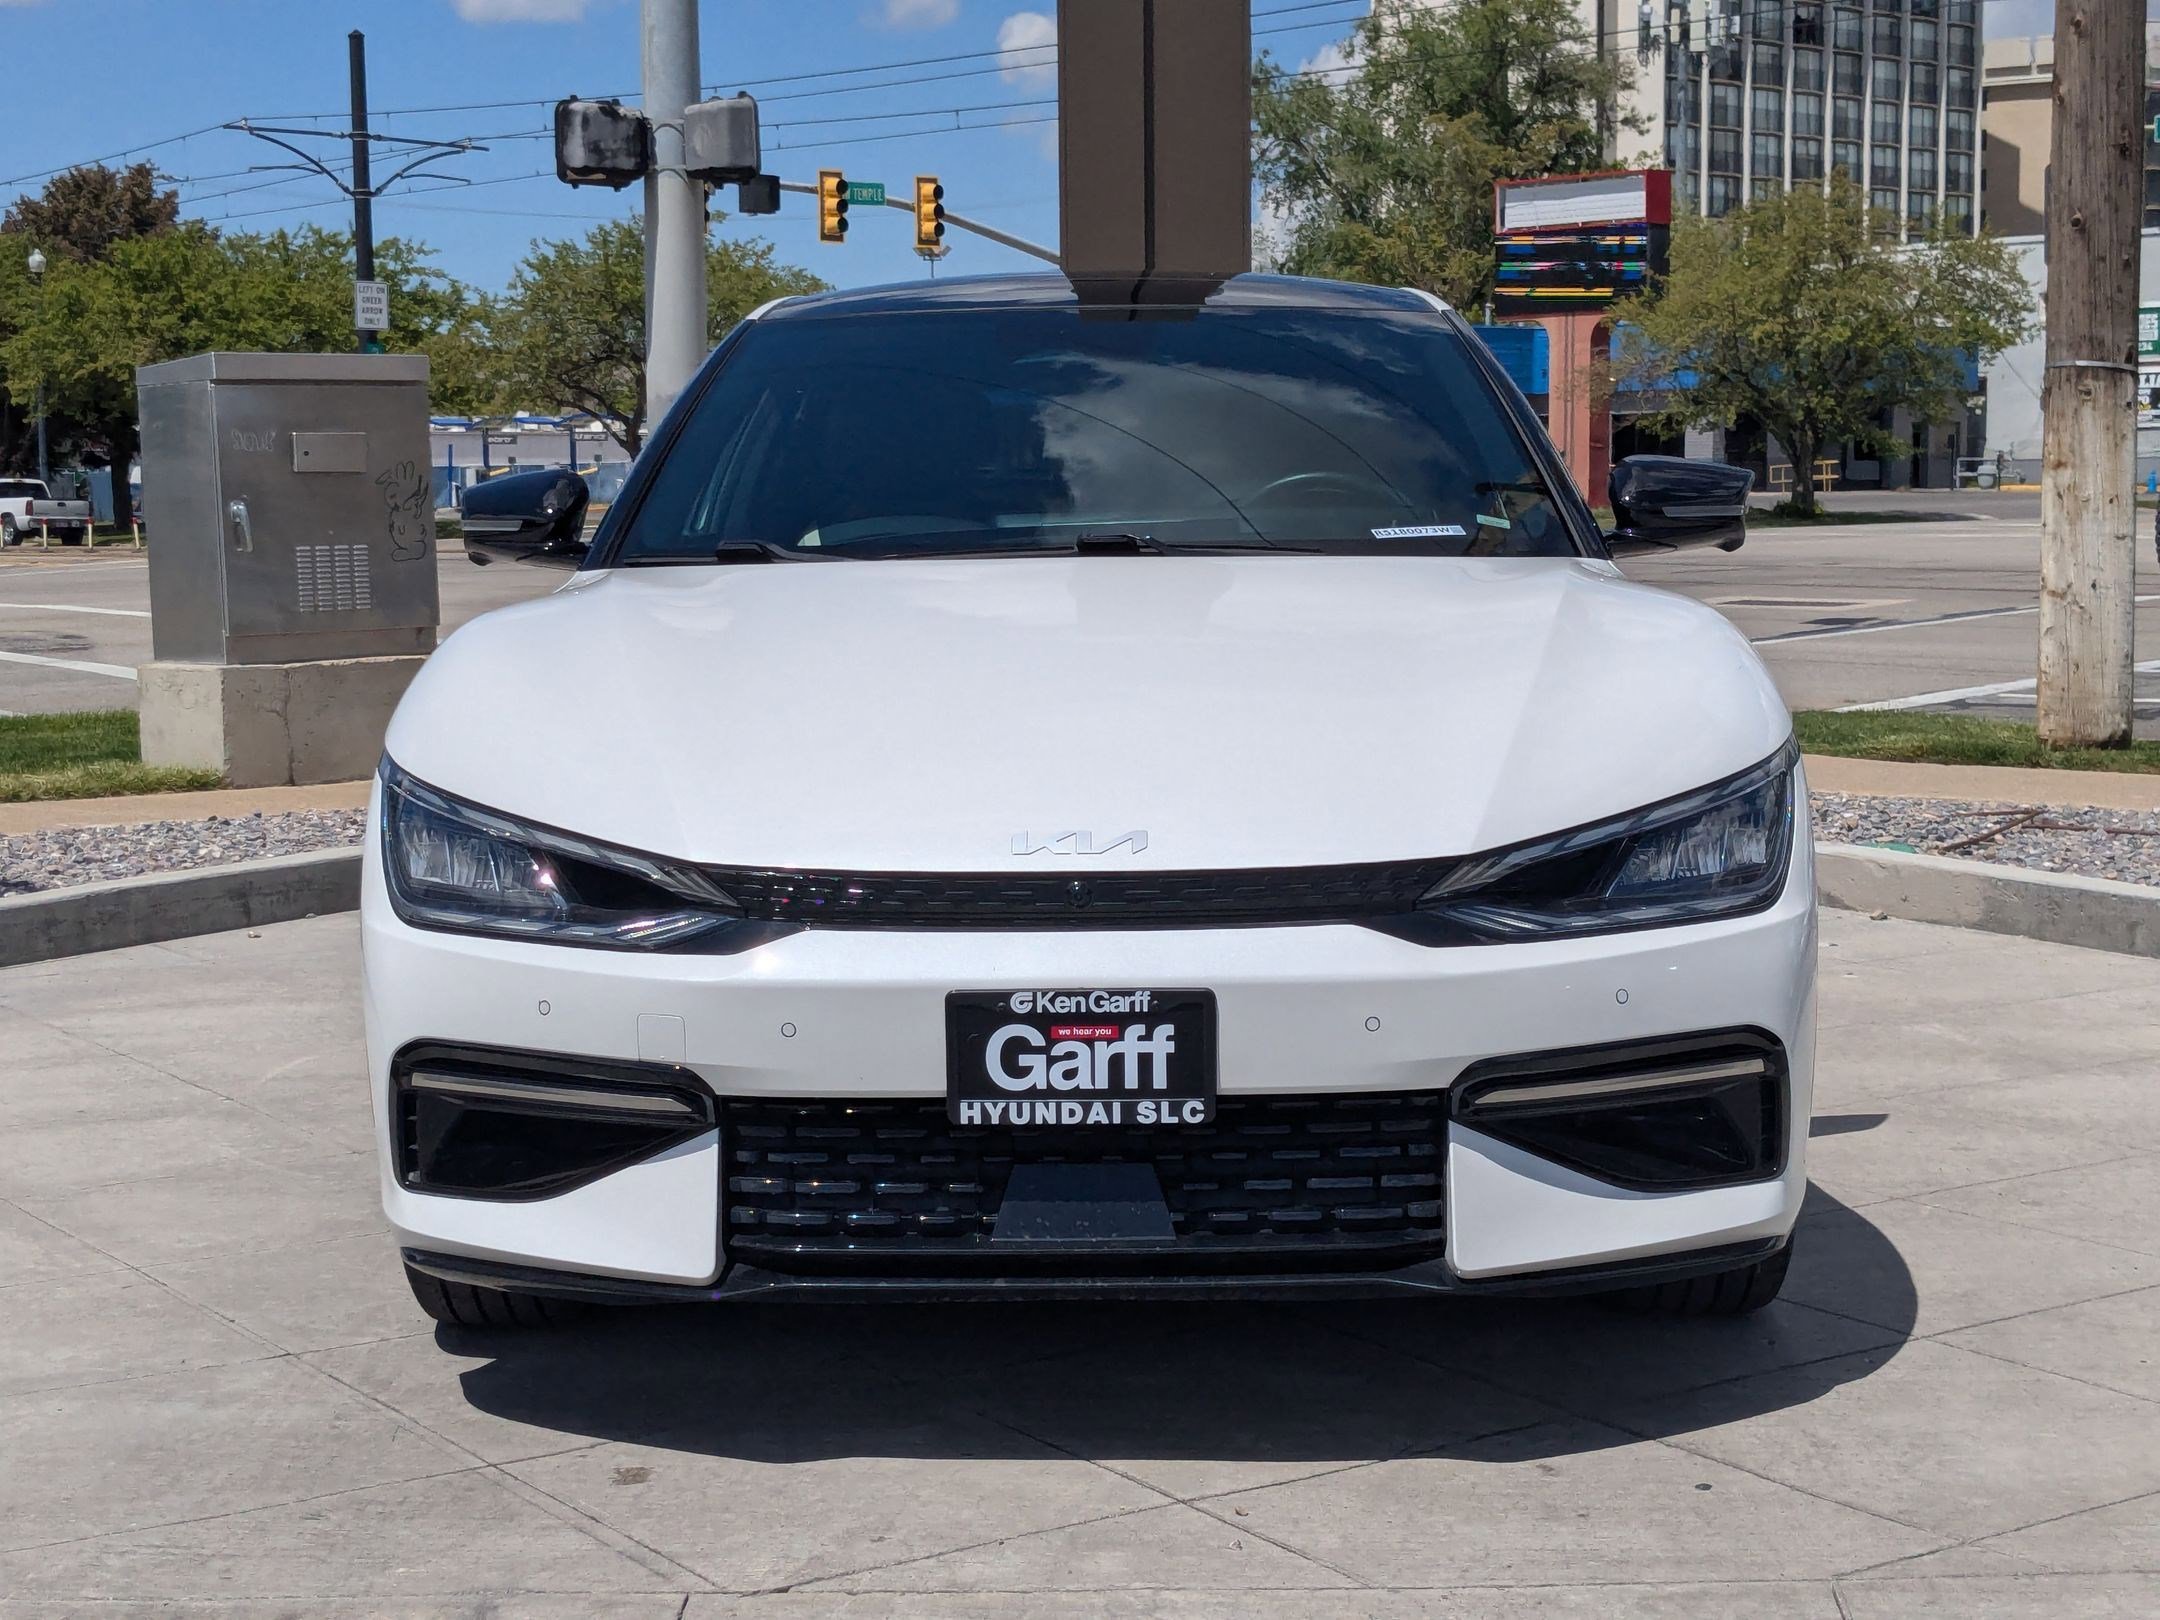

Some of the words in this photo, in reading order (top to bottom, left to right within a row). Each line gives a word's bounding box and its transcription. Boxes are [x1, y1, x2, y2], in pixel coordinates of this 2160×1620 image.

[853, 188, 884, 201] TEMPLE
[359, 285, 373, 293] LEFT
[376, 286, 386, 294] ON
[362, 296, 382, 304] GREEN
[361, 307, 383, 315] ARROW
[364, 317, 380, 326] ONLY
[1011, 829, 1148, 855] KIA
[1036, 991, 1086, 1013] Ken
[1089, 990, 1151, 1013] Garff
[1058, 1027, 1071, 1036] we
[1073, 1026, 1093, 1036] hear
[1095, 1027, 1112, 1037] you
[985, 1023, 1175, 1091] Garff
[960, 1101, 1121, 1125] HYUNDAI
[1136, 1100, 1205, 1124] SLC
